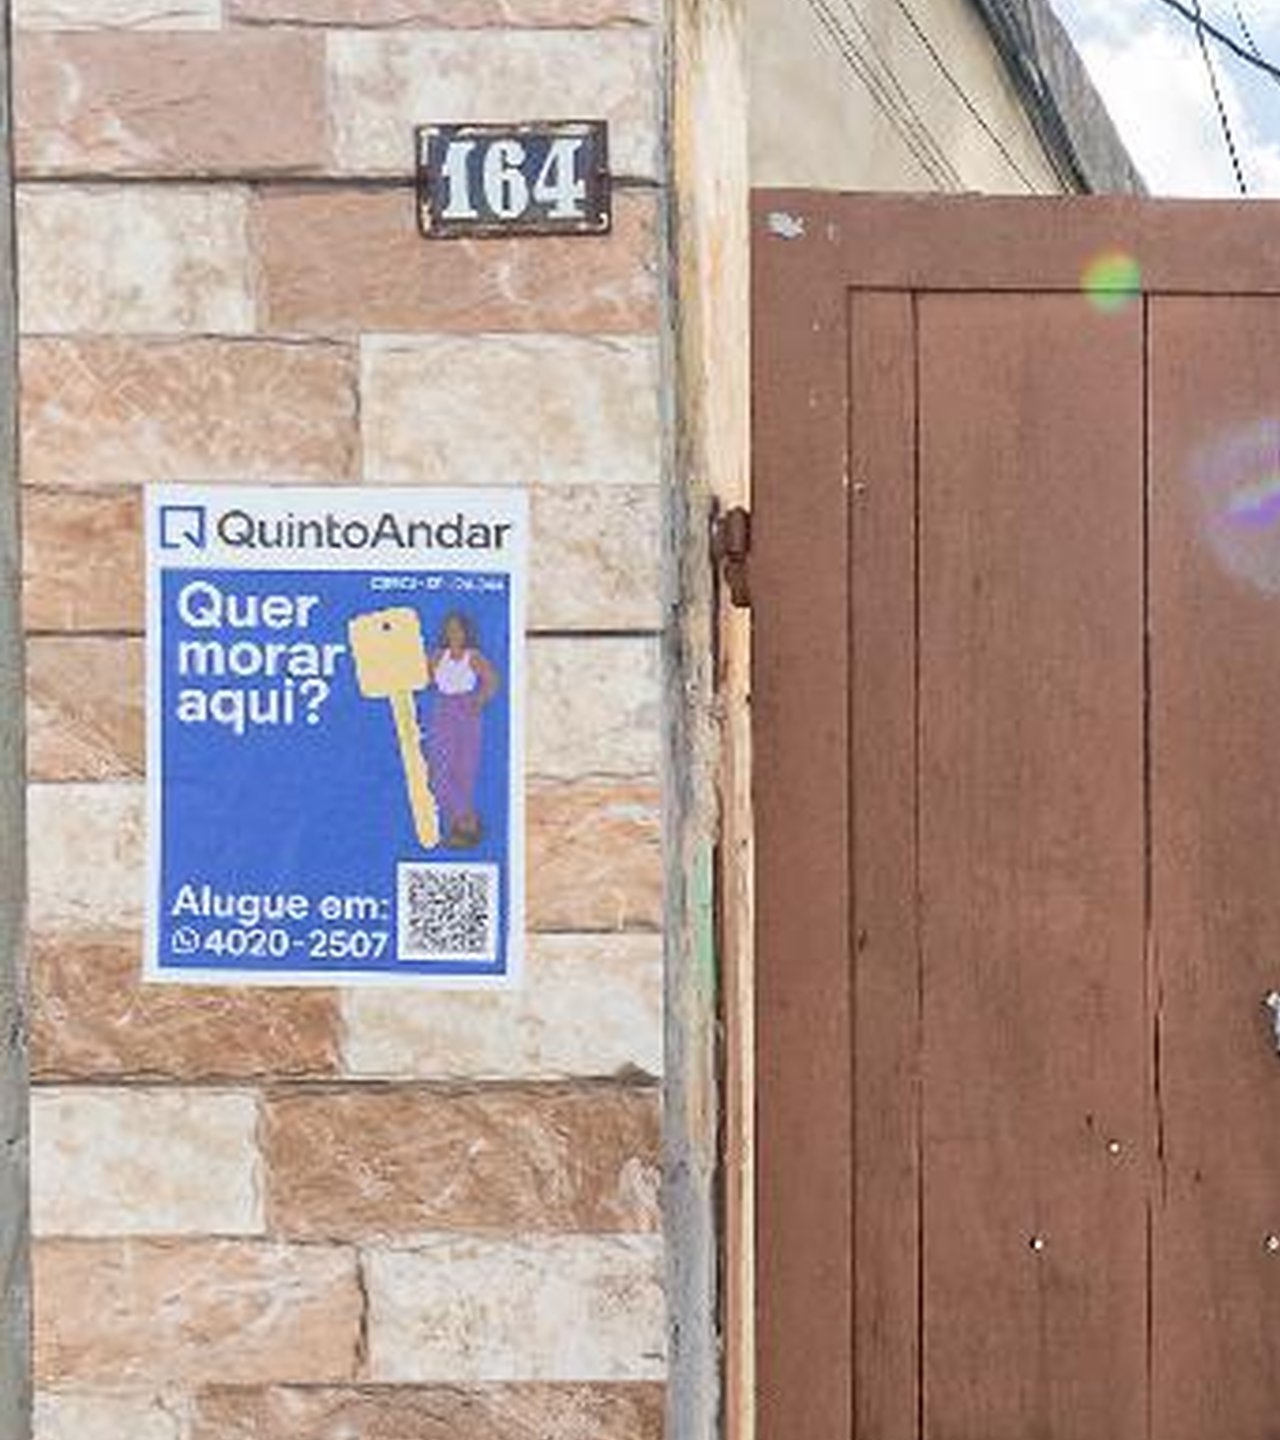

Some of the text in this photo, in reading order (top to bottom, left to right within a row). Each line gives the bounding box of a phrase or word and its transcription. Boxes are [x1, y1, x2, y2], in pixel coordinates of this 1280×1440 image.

[441, 138, 586, 219] 164
[217, 510, 510, 550] QuintoAndar
[178, 581, 319, 629] Quer
[178, 641, 346, 677] morar
[177, 678, 331, 734] aqui?
[172, 883, 389, 926] Alugue em:
[205, 929, 388, 958] 4020-2507
